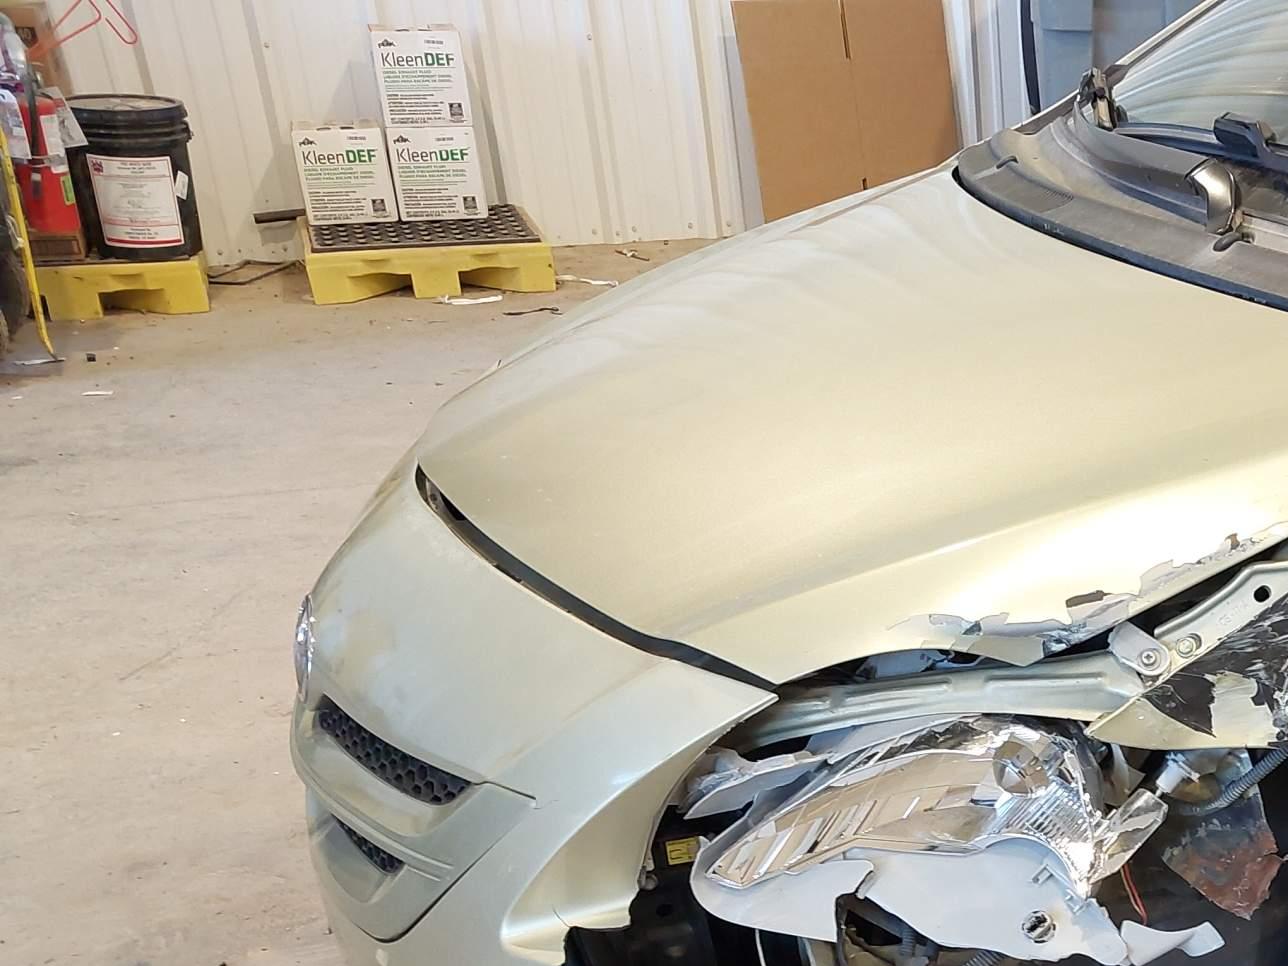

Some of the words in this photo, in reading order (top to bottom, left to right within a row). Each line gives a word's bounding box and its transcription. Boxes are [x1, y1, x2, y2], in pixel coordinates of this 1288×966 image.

[381, 51, 455, 67] KleenDEF
[302, 149, 377, 165] KleenDEF
[396, 147, 469, 162] KleenDEF
